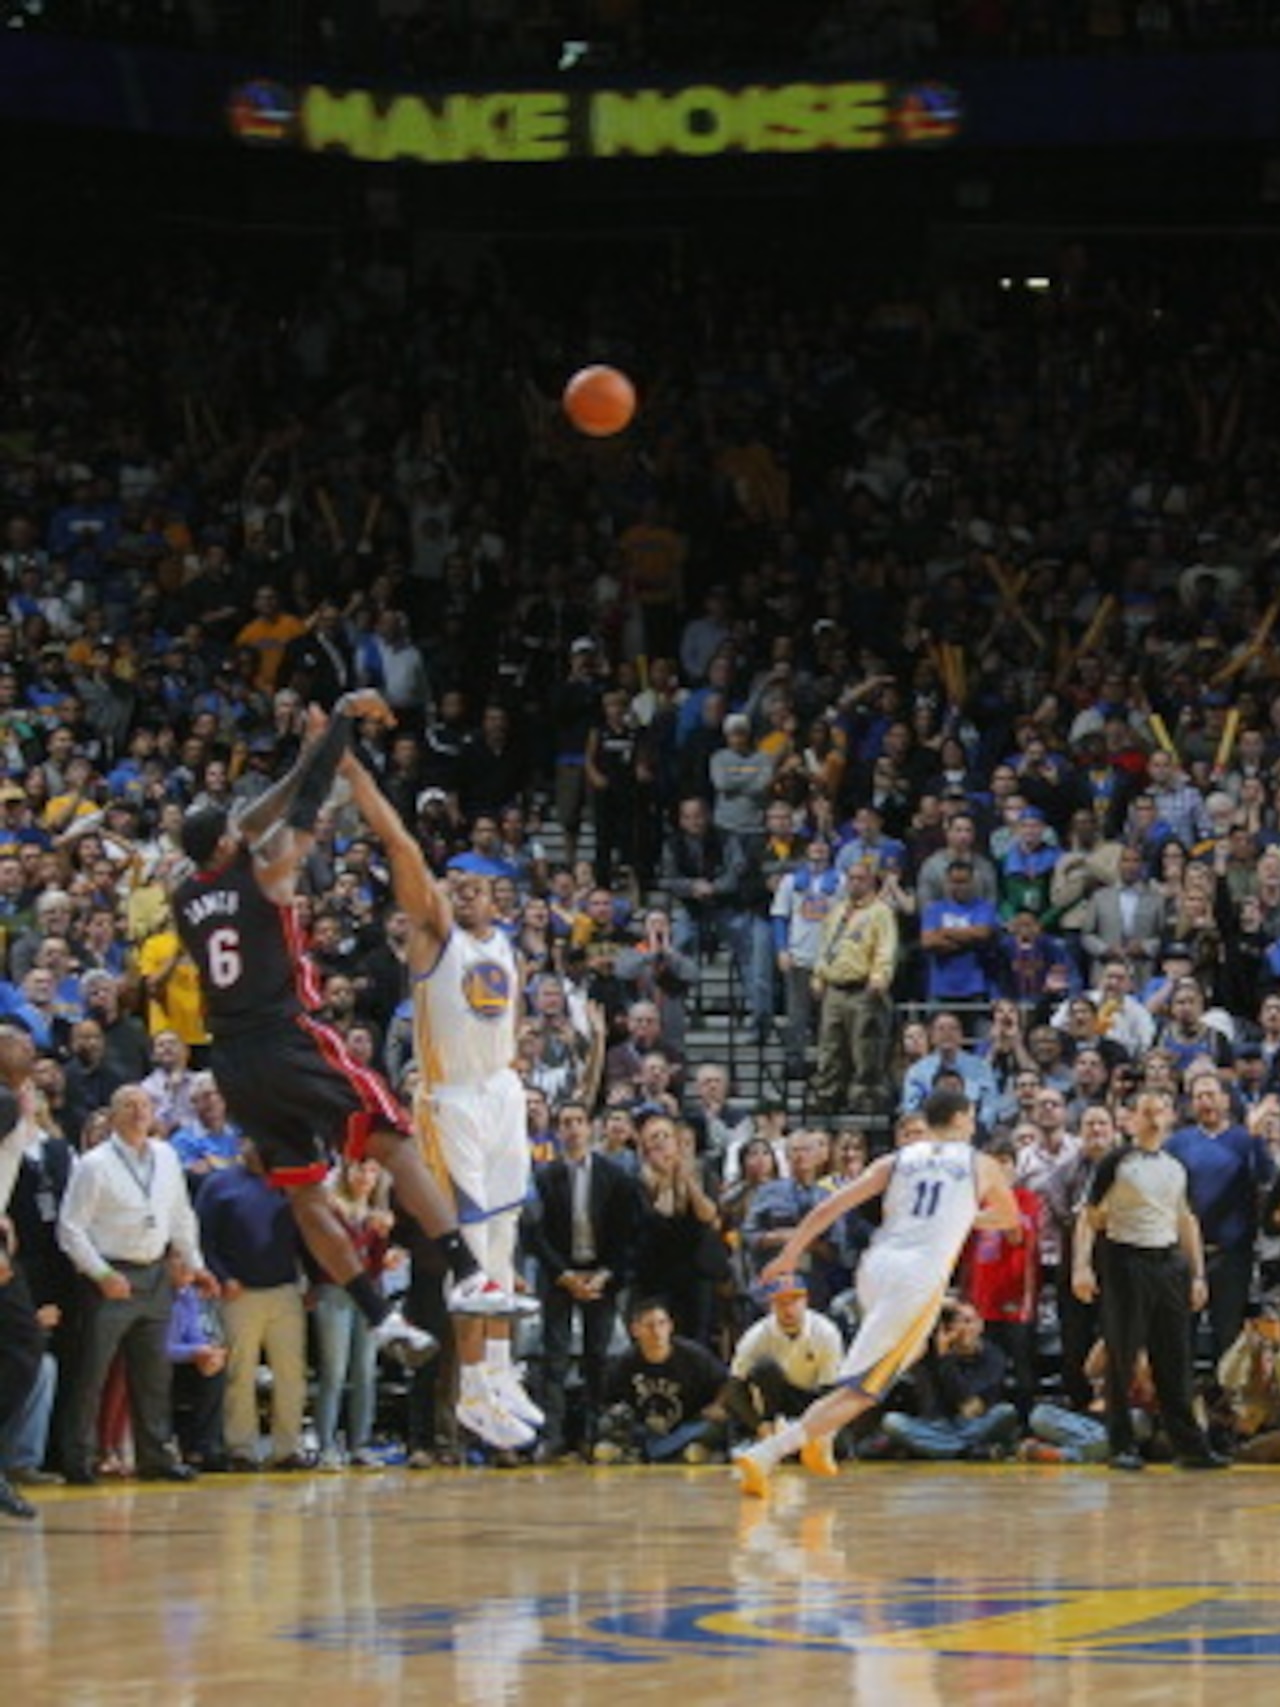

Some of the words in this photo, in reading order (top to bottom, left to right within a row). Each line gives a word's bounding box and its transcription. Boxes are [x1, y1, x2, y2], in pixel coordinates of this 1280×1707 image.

[305, 84, 569, 162] MAKE
[590, 82, 886, 157] NOISE
[208, 927, 242, 990] 6
[911, 1180, 945, 1217] 11
